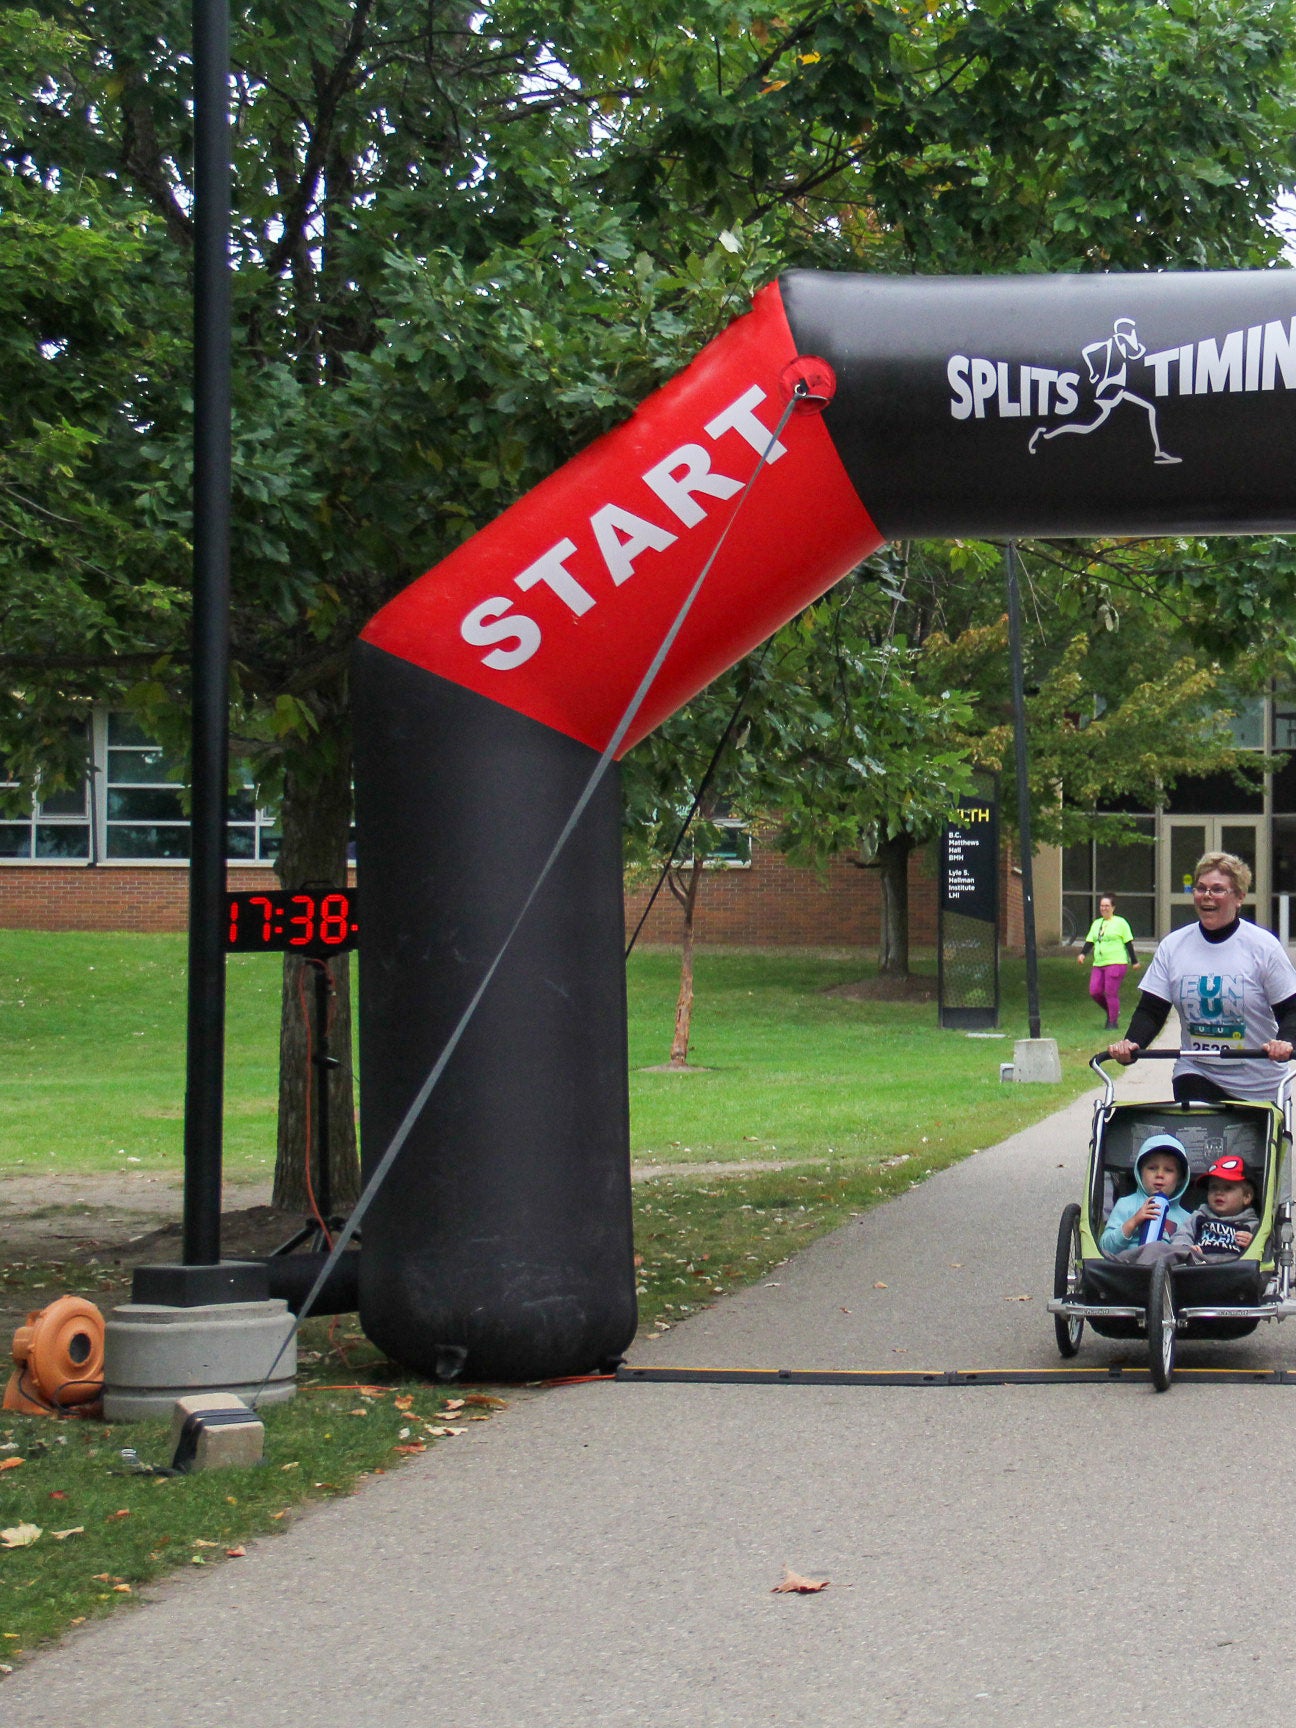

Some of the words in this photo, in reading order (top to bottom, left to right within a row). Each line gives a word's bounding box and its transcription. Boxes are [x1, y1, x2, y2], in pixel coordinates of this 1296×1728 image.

[946, 354, 1080, 420] SPLITS
[460, 384, 788, 671] START
[948, 869, 962, 877] Lyle
[1181, 974, 1244, 999] FUN
[1182, 997, 1244, 1020] RUN
